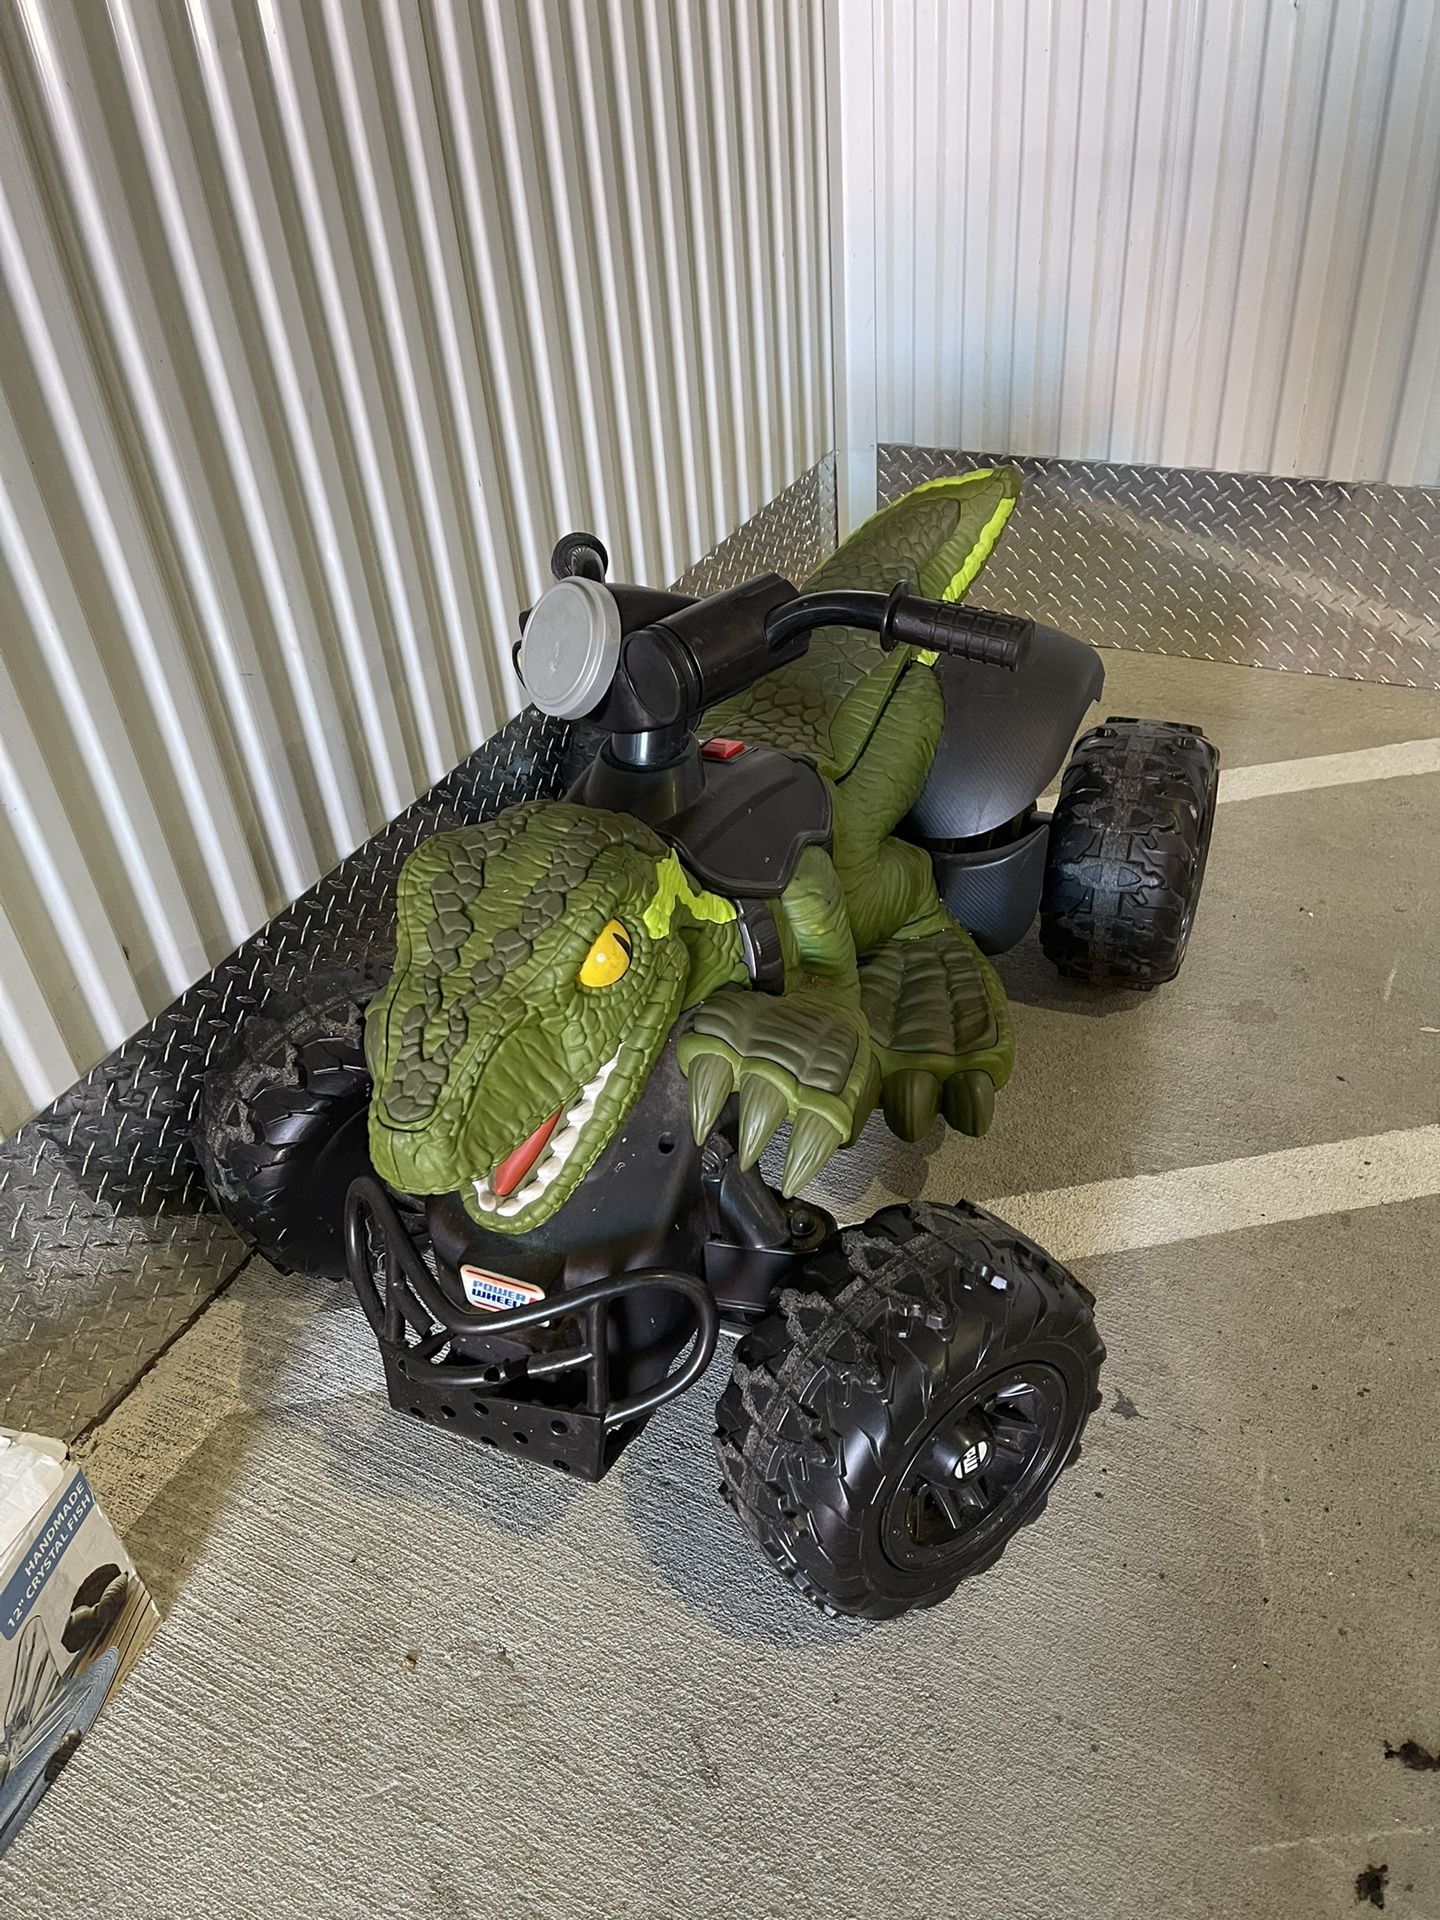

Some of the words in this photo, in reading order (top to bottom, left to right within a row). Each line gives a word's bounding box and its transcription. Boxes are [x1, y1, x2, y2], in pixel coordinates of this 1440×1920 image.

[473, 1280, 526, 1303] POWER
[8, 1599, 25, 1628] 12"
[26, 1533, 69, 1600] CRYSTAL
[67, 1494, 91, 1531] FISH
[25, 1481, 85, 1576] HANDMADE
